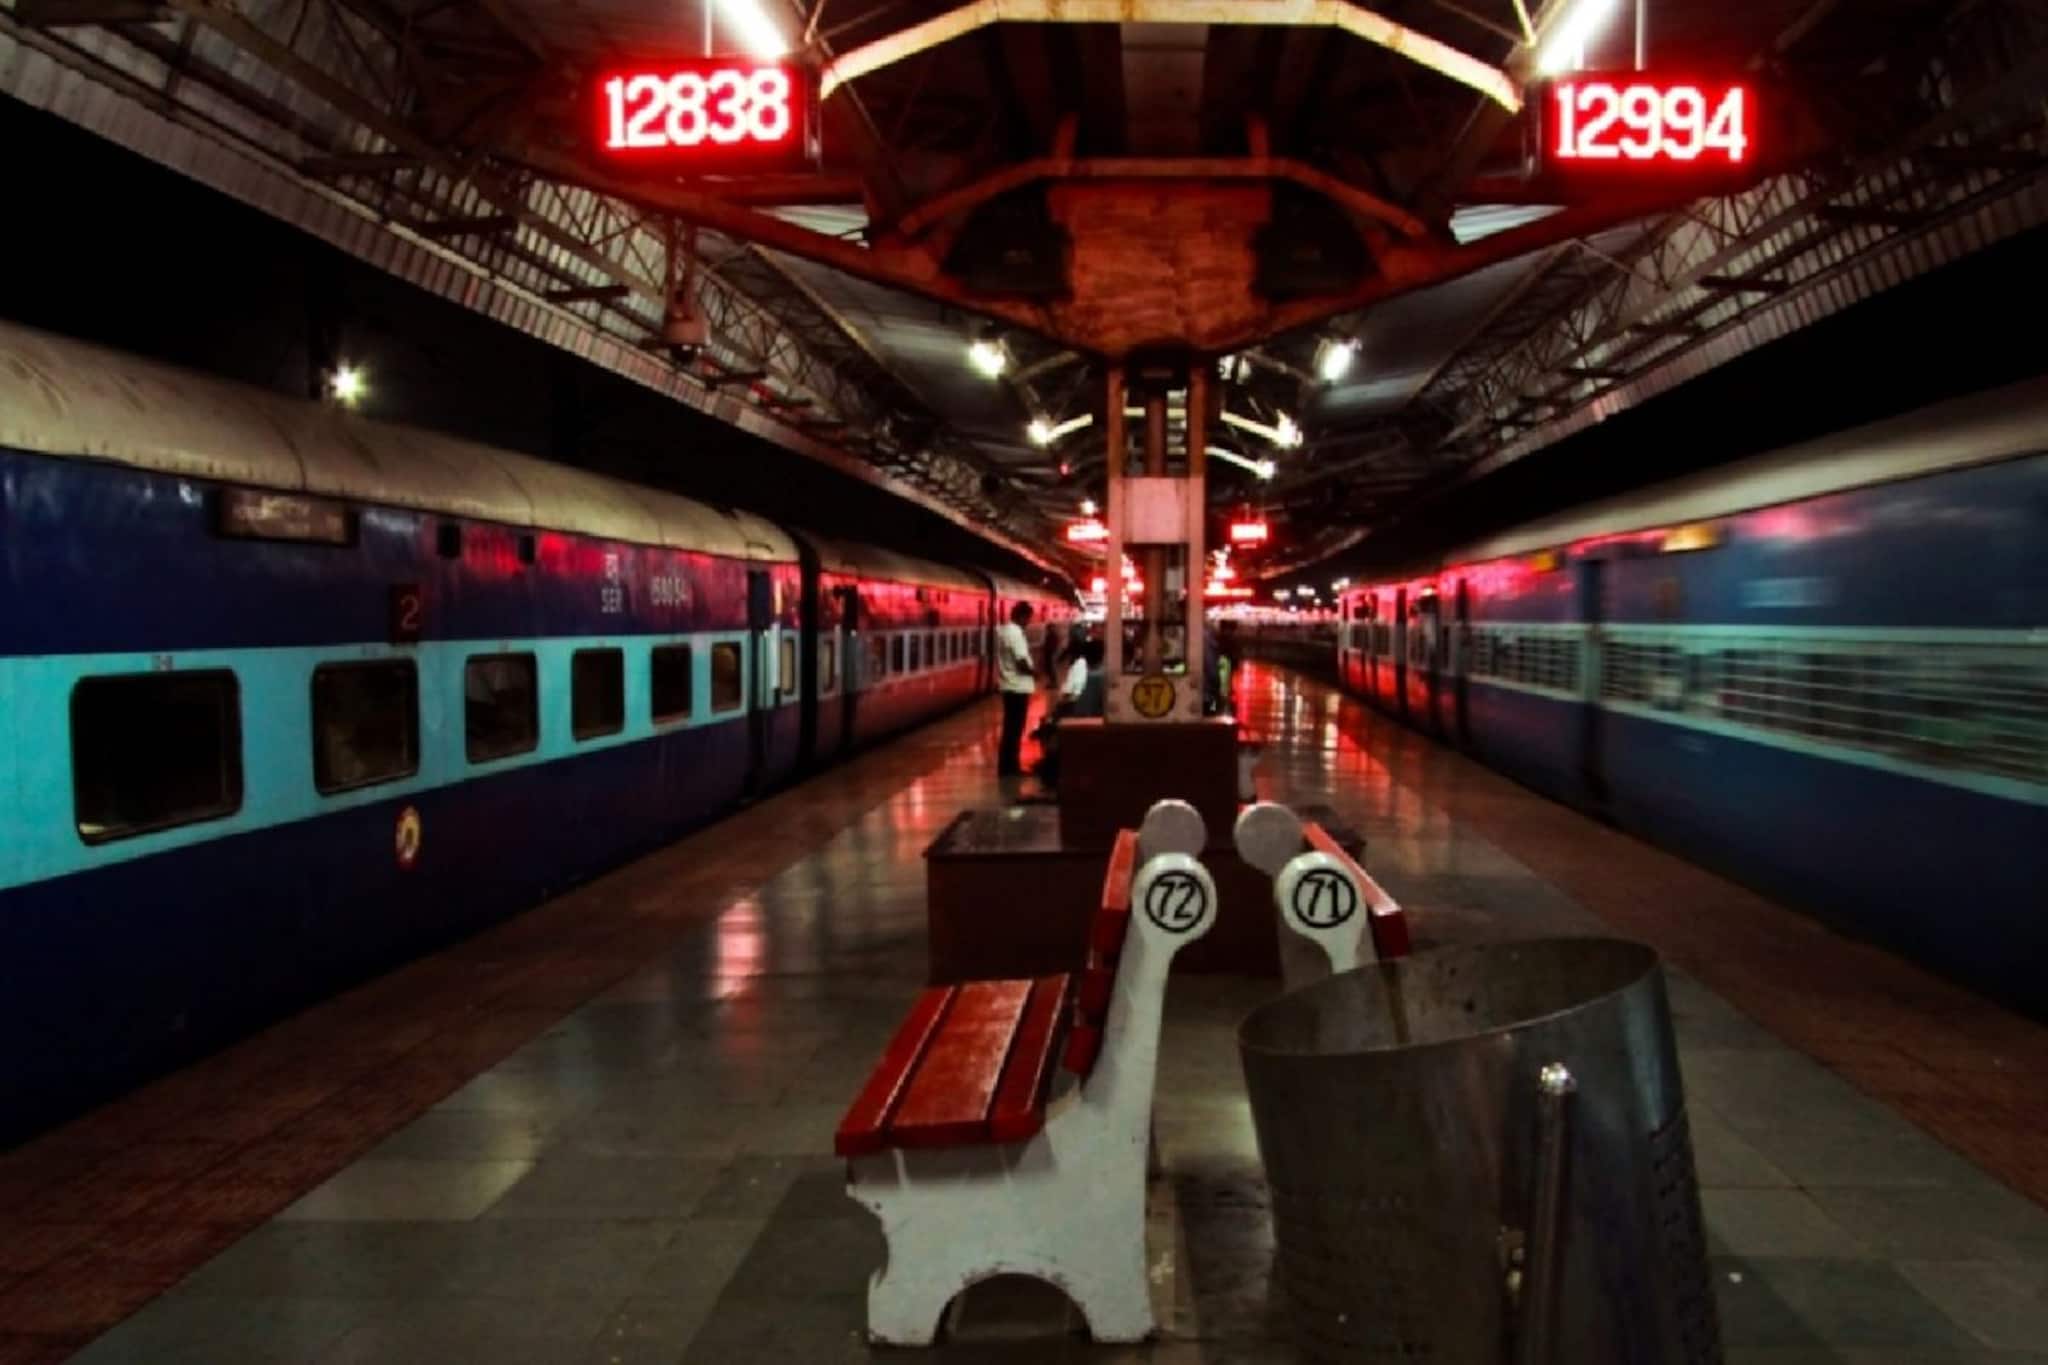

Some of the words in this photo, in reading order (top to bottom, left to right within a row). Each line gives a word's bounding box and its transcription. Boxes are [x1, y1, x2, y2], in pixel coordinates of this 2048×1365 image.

[605, 69, 789, 148] 12838
[1557, 83, 1747, 162] 12994
[401, 592, 420, 631] 2
[1157, 880, 1195, 919] 72
[1303, 877, 1341, 919] 71
